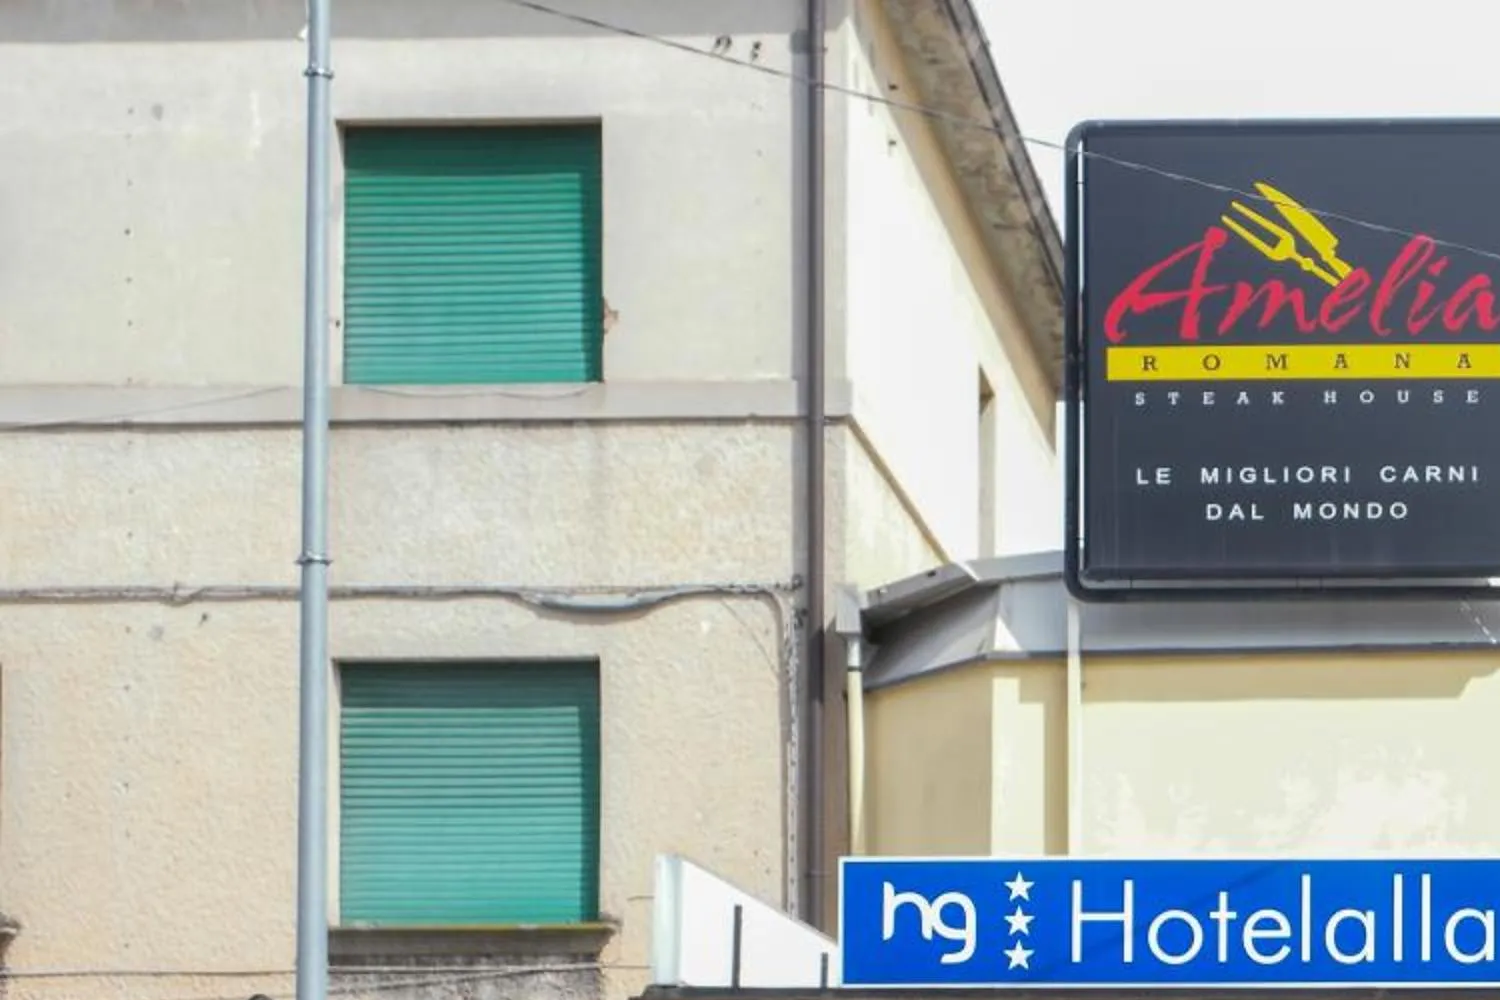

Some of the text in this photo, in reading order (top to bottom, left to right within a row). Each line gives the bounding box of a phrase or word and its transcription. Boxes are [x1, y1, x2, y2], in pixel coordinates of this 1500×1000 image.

[1142, 352, 1473, 372] ROMANA
[1134, 389, 1480, 406] STEAK HOUSE
[1136, 465, 1479, 485] LE MIGLIORI CARNI
[1205, 501, 1409, 522] DAL MONDO
[882, 881, 977, 964] hg
